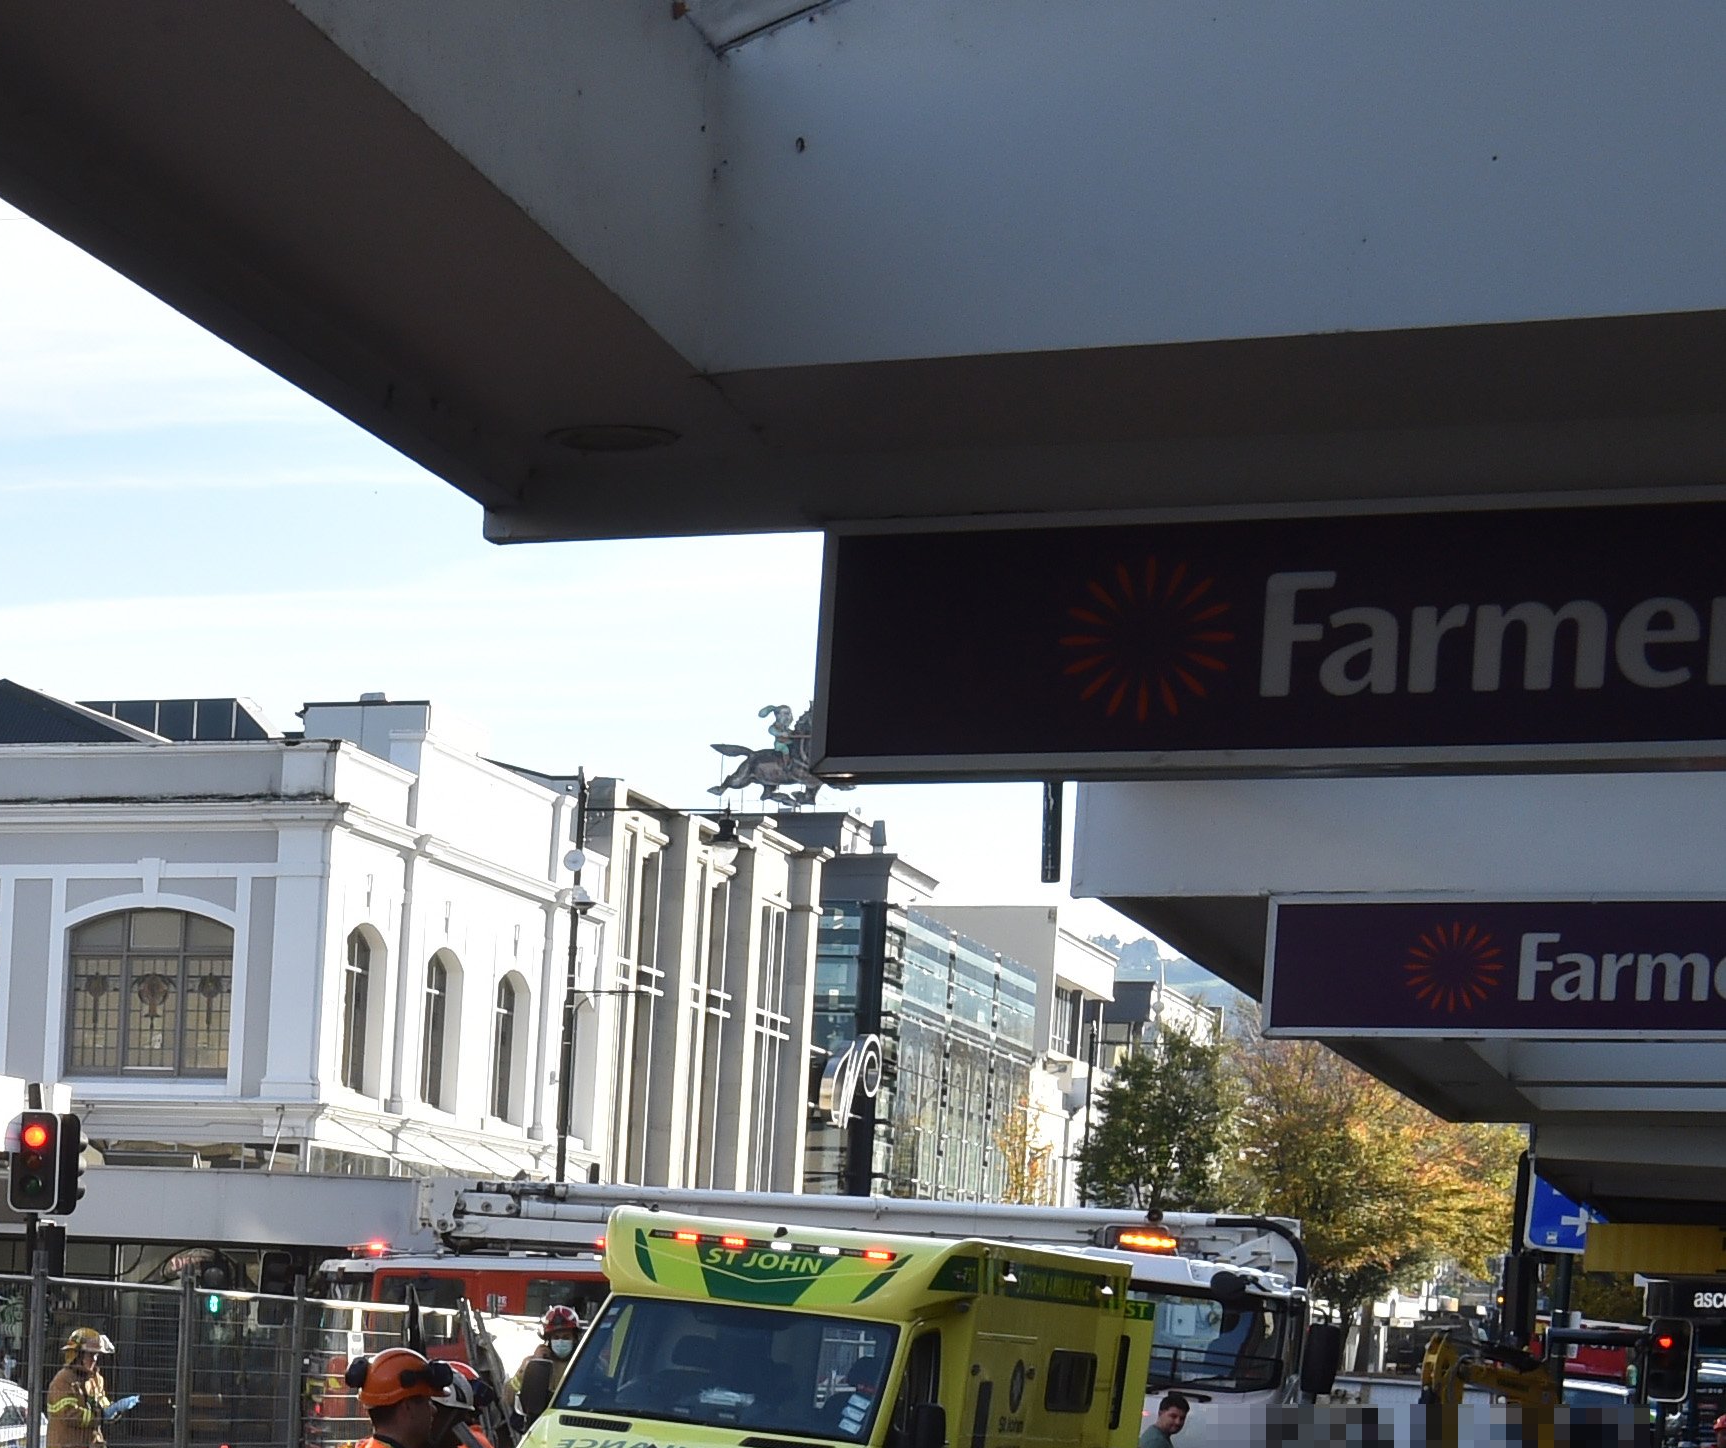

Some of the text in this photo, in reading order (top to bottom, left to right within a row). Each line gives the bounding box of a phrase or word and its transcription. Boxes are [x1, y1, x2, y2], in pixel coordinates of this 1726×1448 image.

[1516, 930, 1726, 1004] Farm
[705, 1247, 823, 1275] ST JOHN
